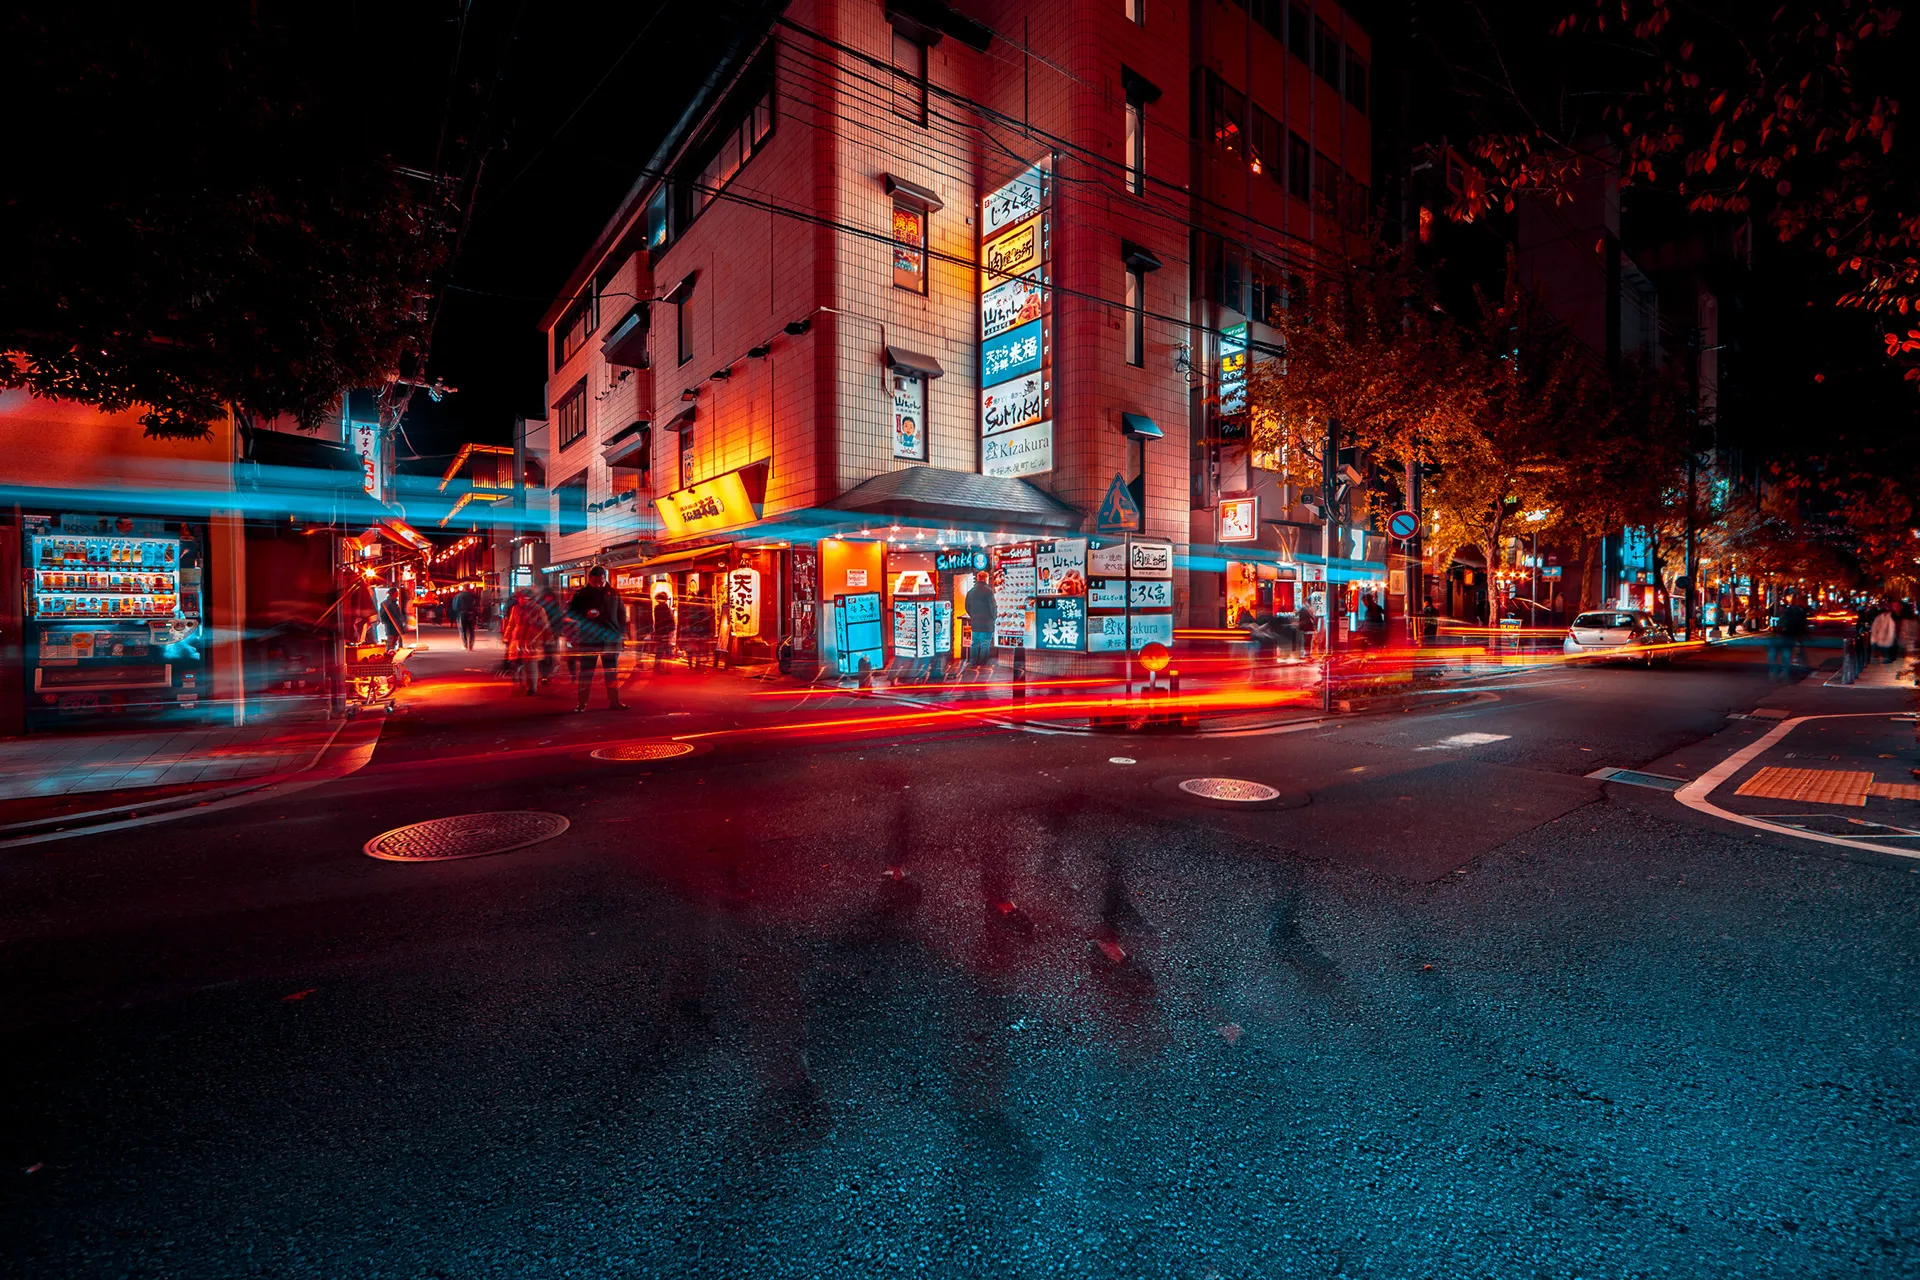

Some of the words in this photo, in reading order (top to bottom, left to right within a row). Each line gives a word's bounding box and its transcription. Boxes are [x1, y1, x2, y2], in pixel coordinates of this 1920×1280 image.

[992, 186, 1033, 226] じろく亭
[984, 300, 1024, 328] 山ちゃん
[986, 345, 1009, 365] 天ぷら
[1009, 336, 1038, 364] 米福
[1000, 437, 1049, 458] Kizakura
[1052, 556, 1084, 569] 山ちゃん
[733, 574, 753, 625] 天ぷら
[1057, 599, 1077, 610] 天ぷら
[1042, 618, 1079, 645] 米福
